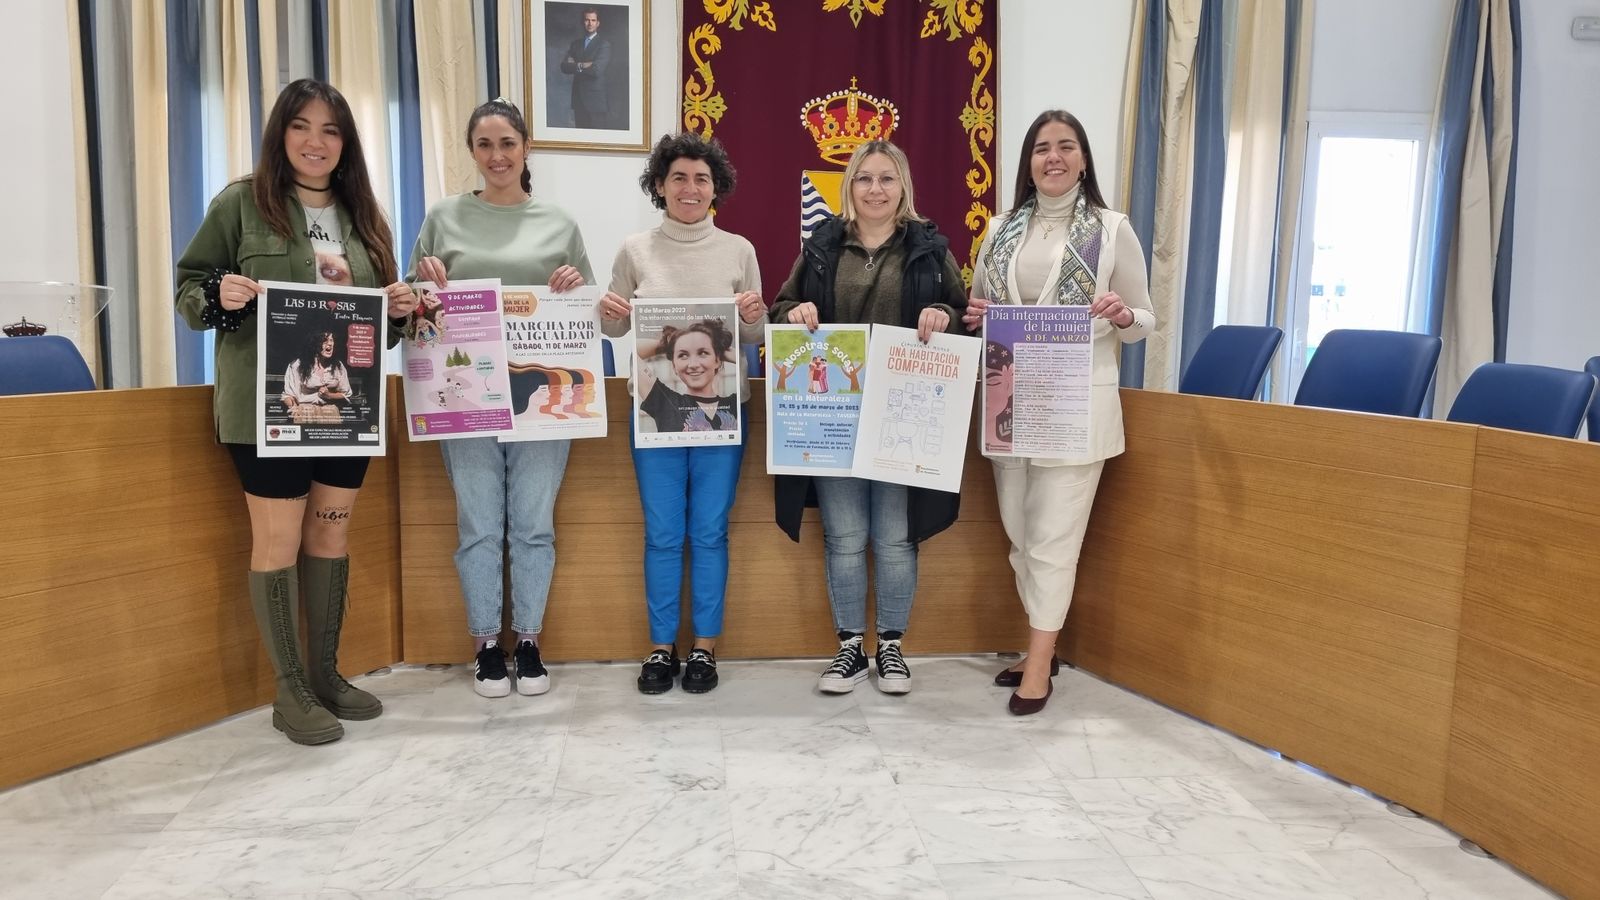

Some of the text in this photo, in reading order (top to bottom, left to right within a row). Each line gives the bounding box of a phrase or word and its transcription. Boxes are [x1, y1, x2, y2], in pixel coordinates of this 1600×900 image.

[285, 298, 305, 308] LAS
[307, 300, 317, 309] 13
[991, 309, 1090, 320] Día internacional
[506, 321, 594, 331] MARCHA POR
[1024, 321, 1090, 333] de la mujer
[506, 331, 594, 341] LA IGUALDAD
[513, 342, 544, 350] SÁBADO,
[783, 341, 854, 374] Nosotras solas
[889, 345, 960, 365] UNA HABITACIÓN
[887, 357, 958, 379] COMPARTIDA
